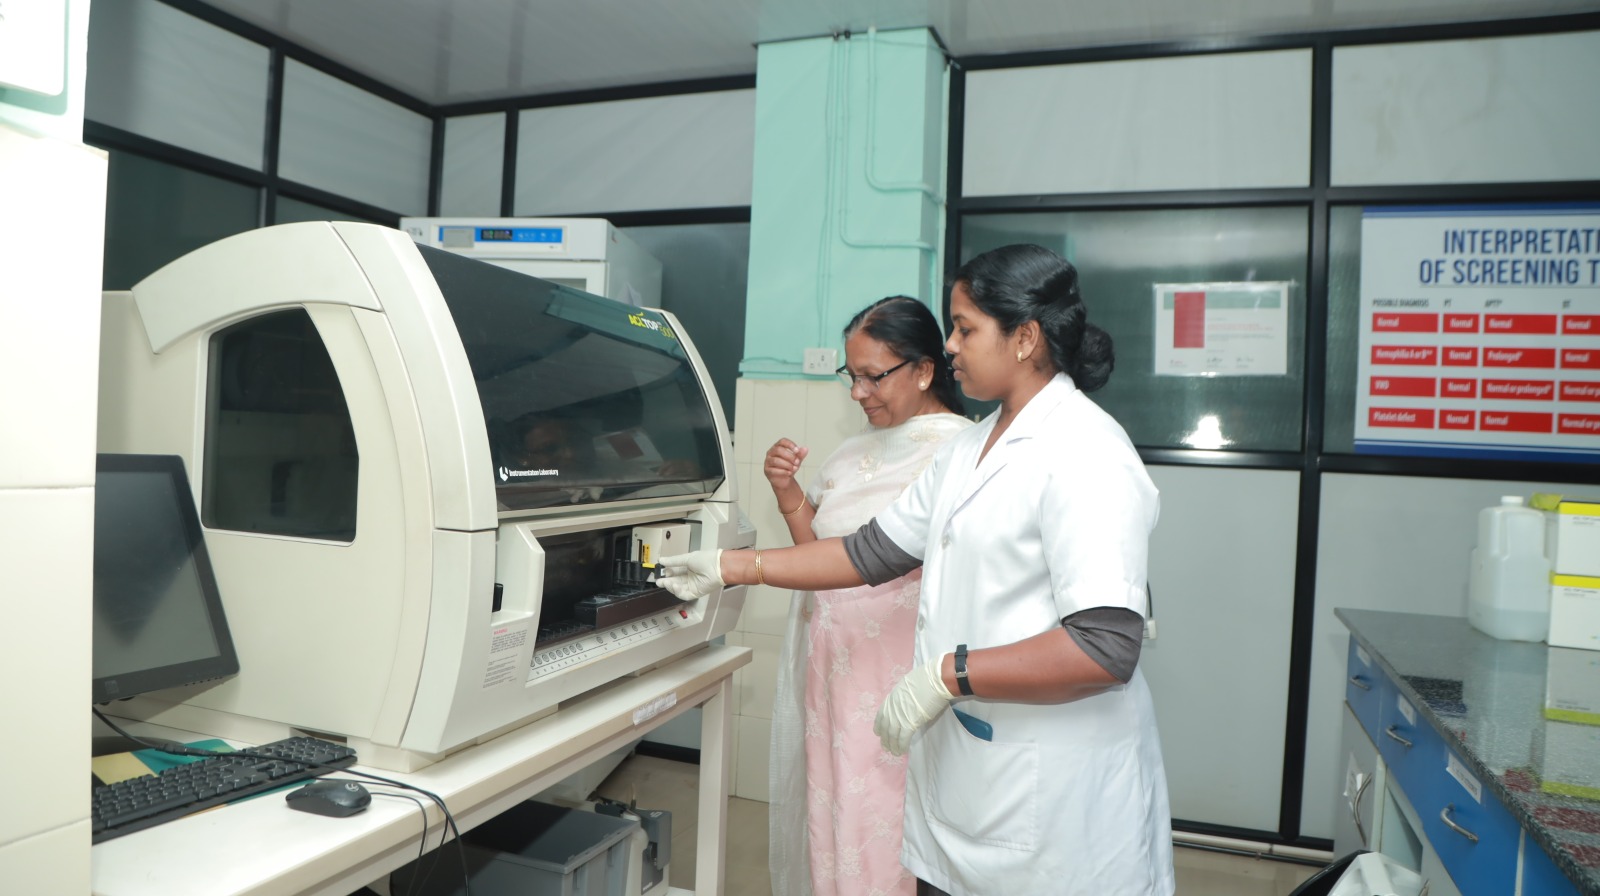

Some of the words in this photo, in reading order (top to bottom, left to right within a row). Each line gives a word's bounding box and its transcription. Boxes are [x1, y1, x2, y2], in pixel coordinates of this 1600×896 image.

[1419, 259, 1446, 284] OF
[1452, 259, 1580, 284] SCREENING
[1372, 299, 1399, 307] POSSIBLE
[1400, 299, 1429, 307] DIAGNOSIS
[1444, 299, 1452, 307] PT
[628, 312, 646, 328] ACL
[1377, 317, 1399, 327] Normal
[1450, 318, 1473, 328] Normal
[1488, 318, 1513, 329] Normal
[1566, 320, 1591, 330] Normal
[1449, 350, 1472, 360] Normal
[1565, 352, 1590, 362] Normal
[1447, 382, 1471, 392] Normal
[1486, 383, 1510, 393] Normal
[1563, 385, 1588, 395] Normal
[1587, 387, 1595, 395] or
[1374, 412, 1396, 421] Platelet
[1397, 413, 1416, 422] defect
[1446, 414, 1469, 424] Normal
[1485, 415, 1509, 425] Normal
[1562, 418, 1587, 428] Normal
[1586, 420, 1594, 428] or
[509, 469, 539, 477] Instrumentation
